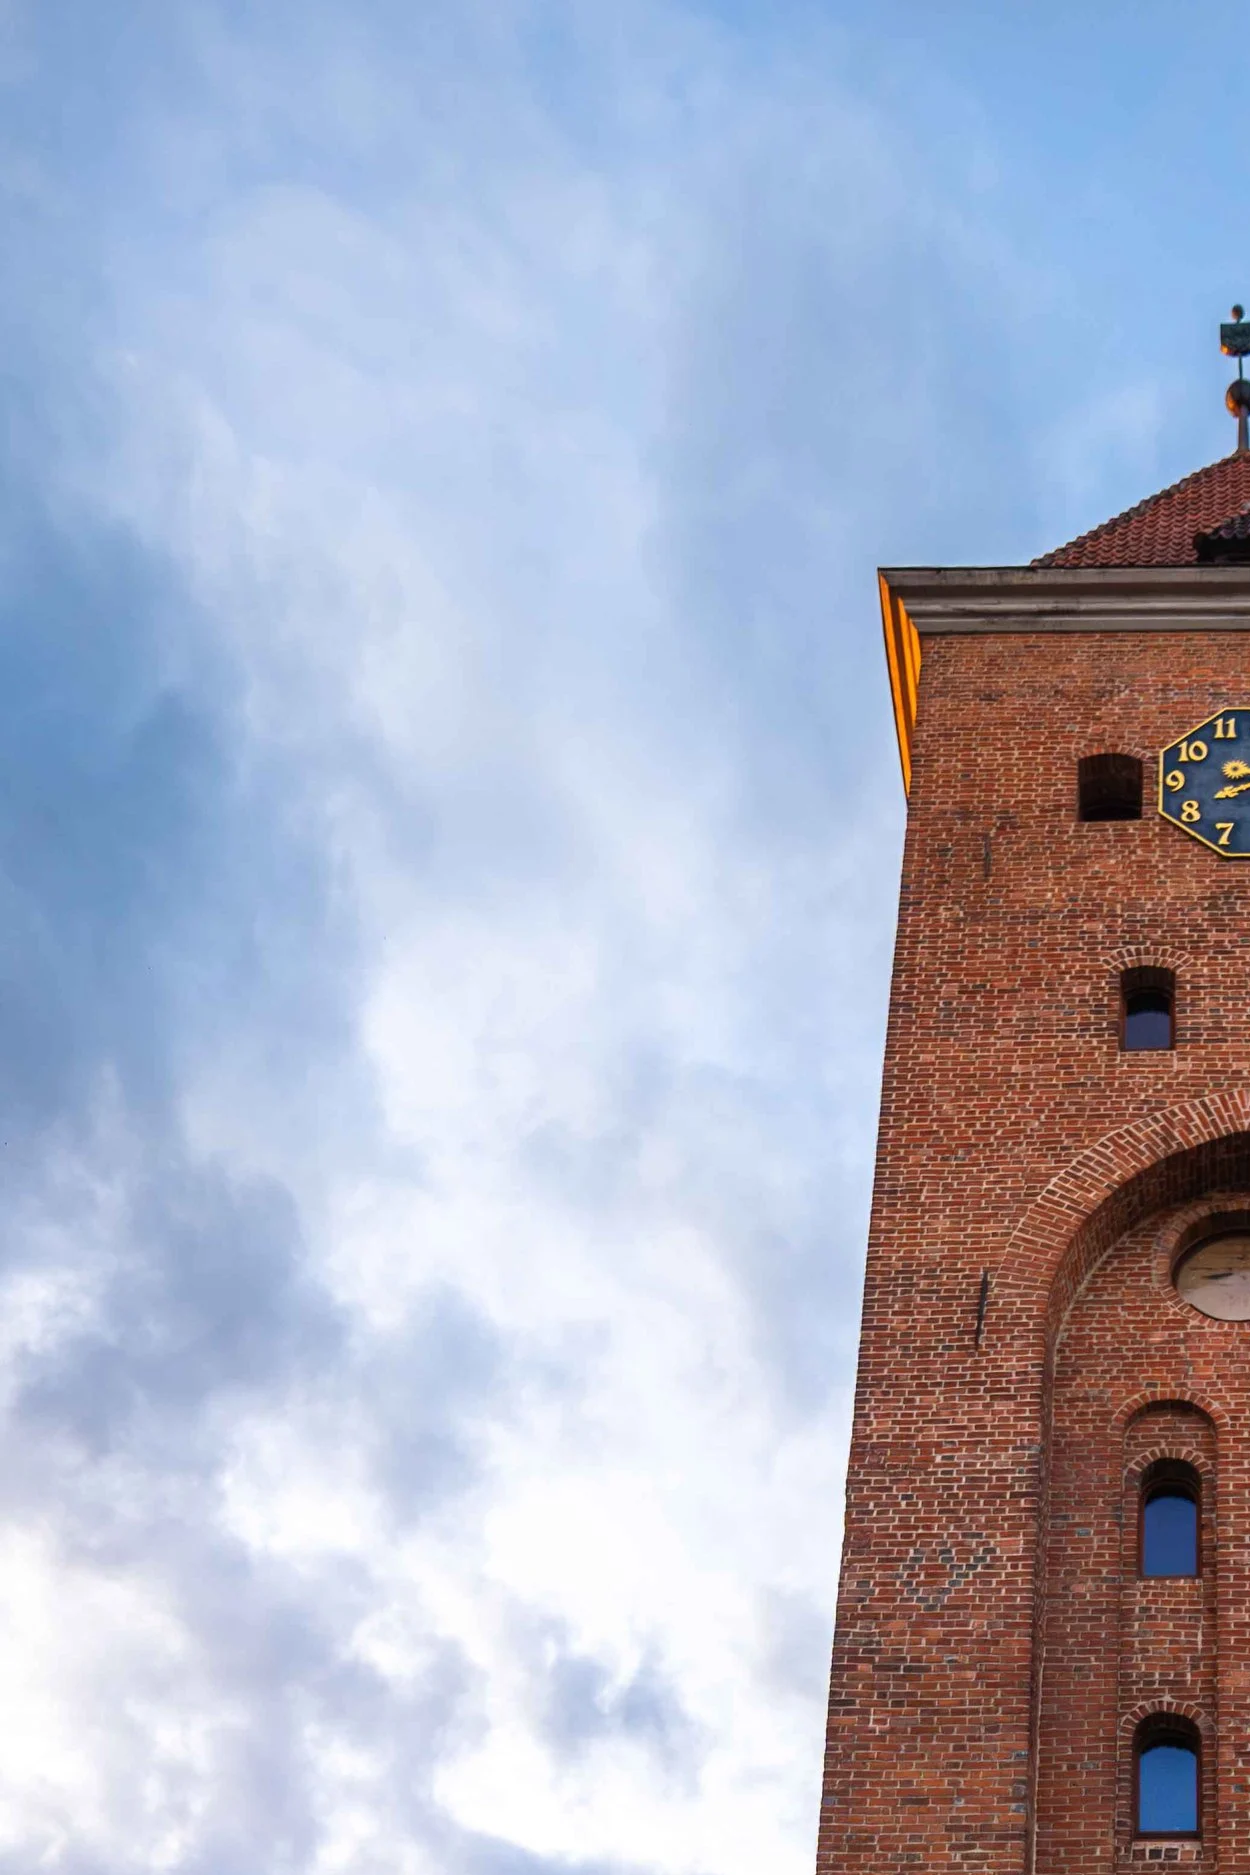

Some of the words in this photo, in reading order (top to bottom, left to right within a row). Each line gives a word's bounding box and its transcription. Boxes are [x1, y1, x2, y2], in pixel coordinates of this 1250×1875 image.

[1213, 718, 1237, 739] 11
[1177, 741, 1208, 762] 10
[1165, 770, 1185, 792] 9
[1181, 800, 1201, 823] 8
[1215, 822, 1234, 845] 7
